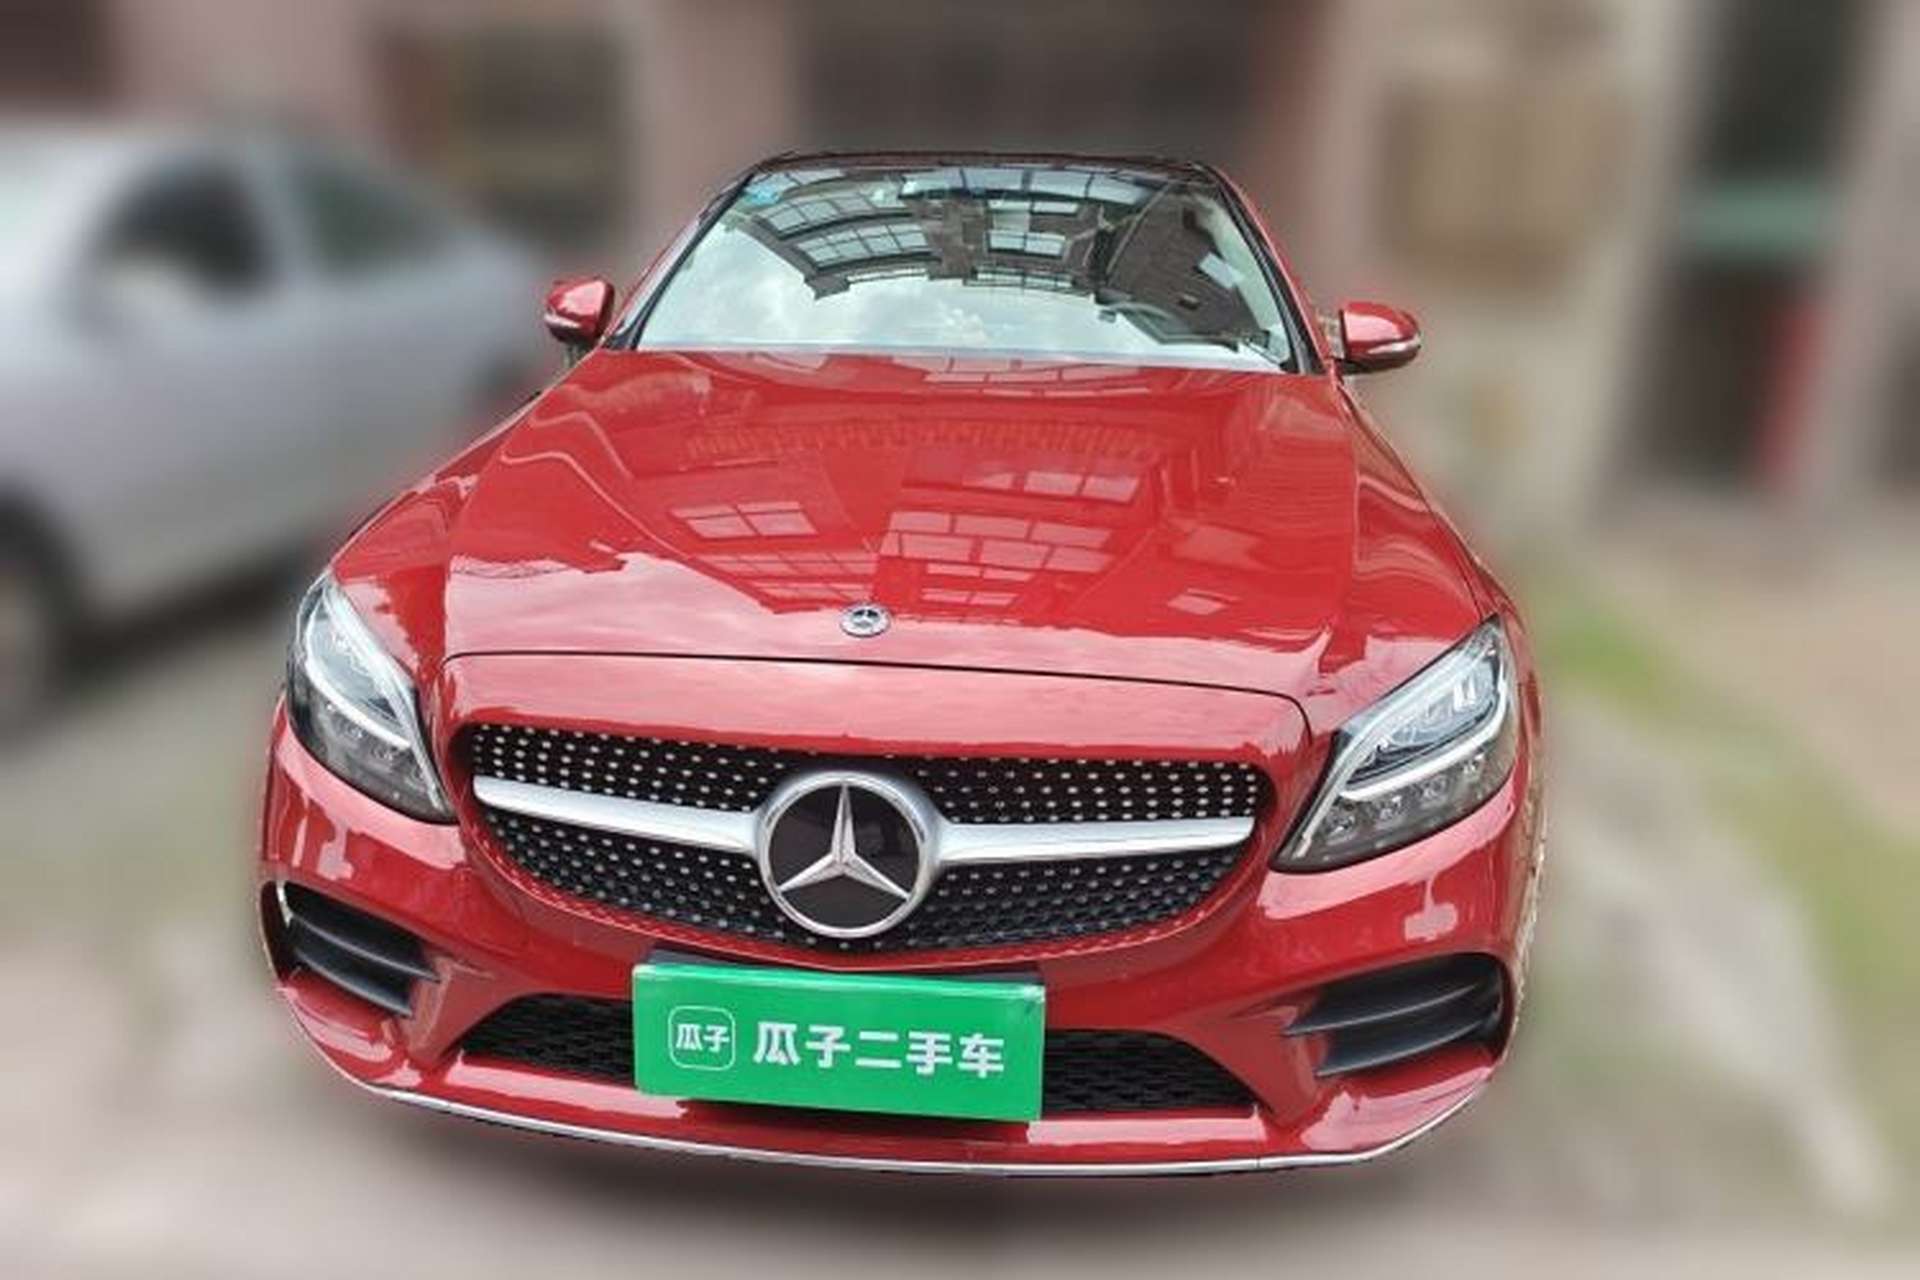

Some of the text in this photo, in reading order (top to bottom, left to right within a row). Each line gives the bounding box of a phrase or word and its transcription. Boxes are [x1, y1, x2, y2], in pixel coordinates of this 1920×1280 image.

[676, 1023, 730, 1053] 瓜子
[753, 1021, 1005, 1078] 瓜子二手车
